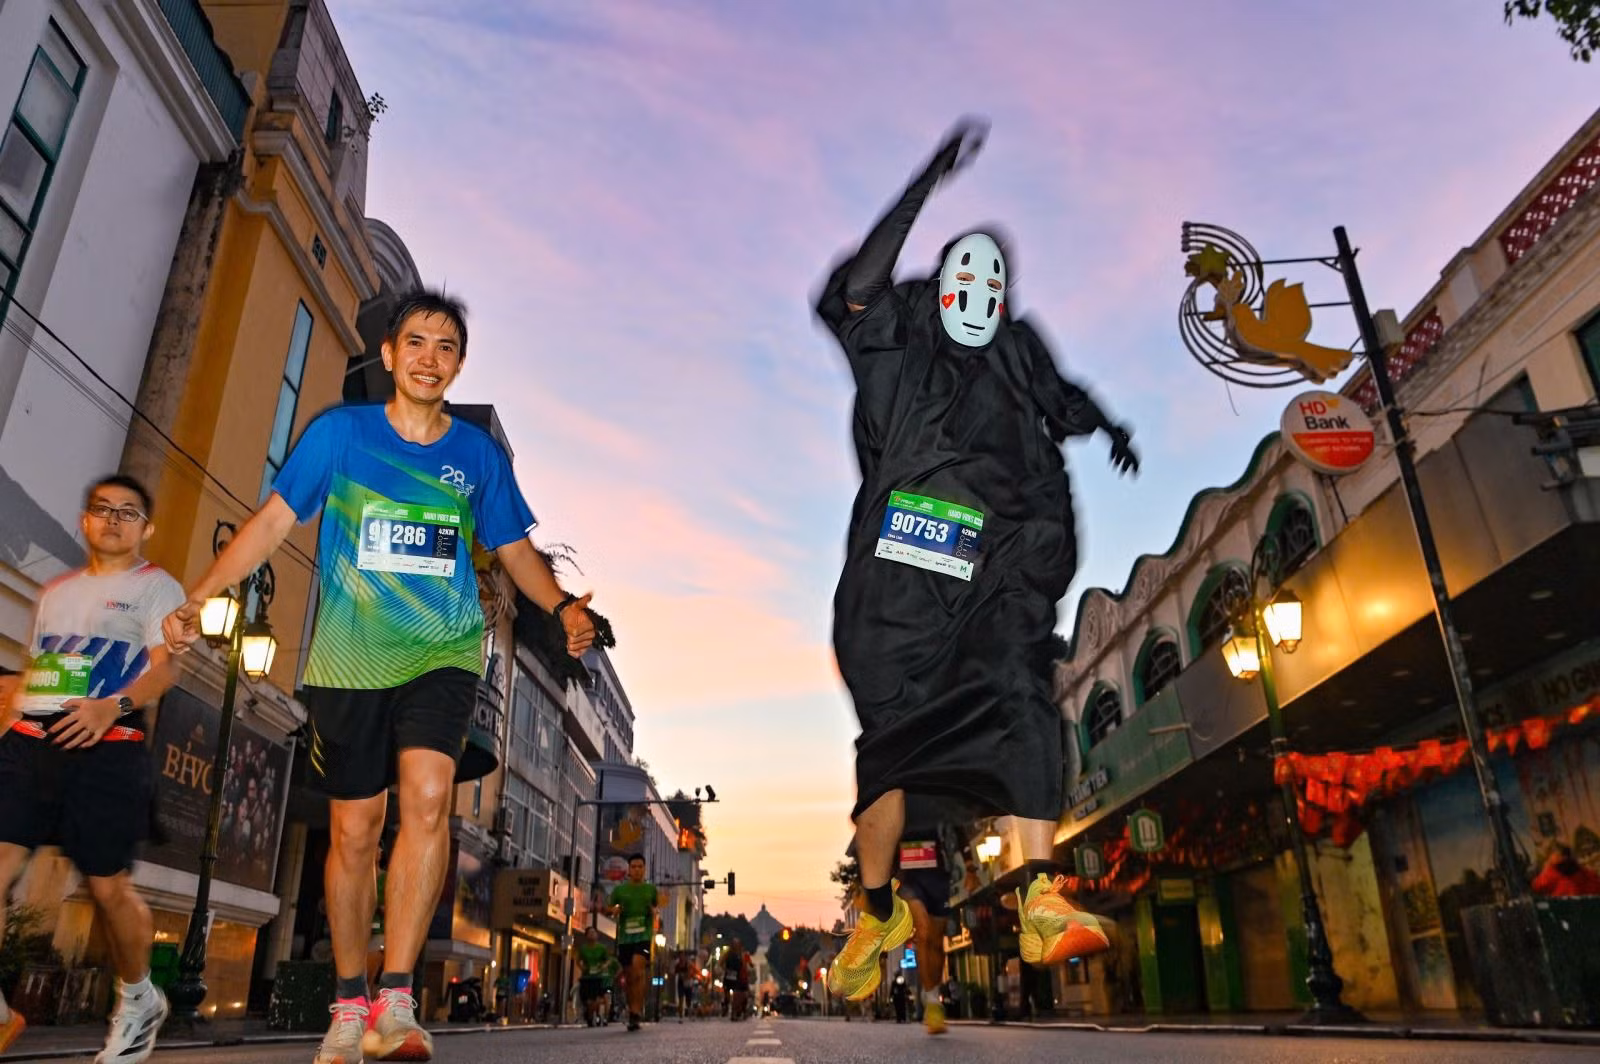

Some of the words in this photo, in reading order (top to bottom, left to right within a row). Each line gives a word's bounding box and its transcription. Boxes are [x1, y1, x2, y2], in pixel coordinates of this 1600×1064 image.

[1299, 401, 1326, 415] HD
[1304, 415, 1351, 430] Bank
[440, 464, 465, 486] 28
[438, 528, 454, 536] 42KM
[890, 511, 949, 543] 90753
[961, 527, 978, 539] 42KM
